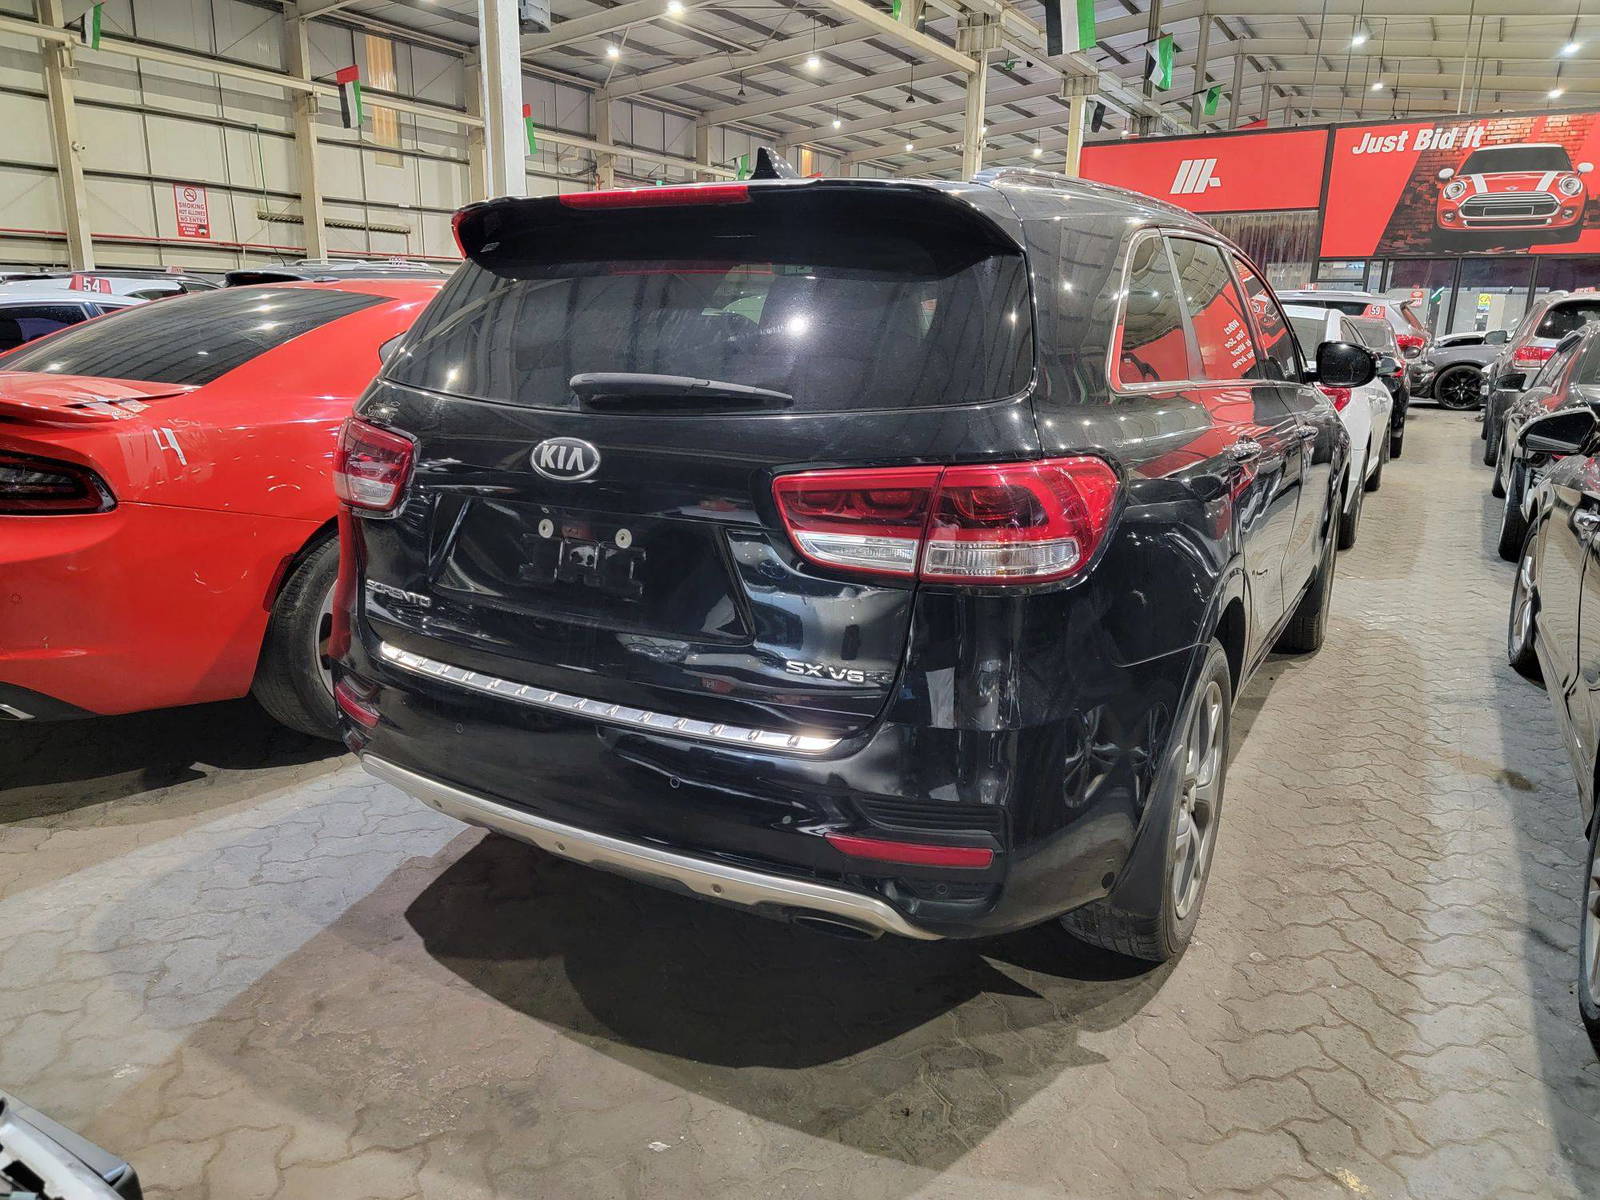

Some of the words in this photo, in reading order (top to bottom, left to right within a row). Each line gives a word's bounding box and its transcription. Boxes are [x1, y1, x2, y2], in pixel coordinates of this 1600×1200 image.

[1352, 130, 1408, 154] Just
[1413, 127, 1458, 151] Bid
[1463, 126, 1484, 148] It
[178, 201, 205, 209] SMOKING
[82, 277, 100, 293] 54
[1370, 306, 1380, 315] 59
[540, 444, 585, 472] KIA
[366, 579, 432, 608] SORENTO
[786, 660, 824, 677] SX
[828, 666, 865, 684] V6
